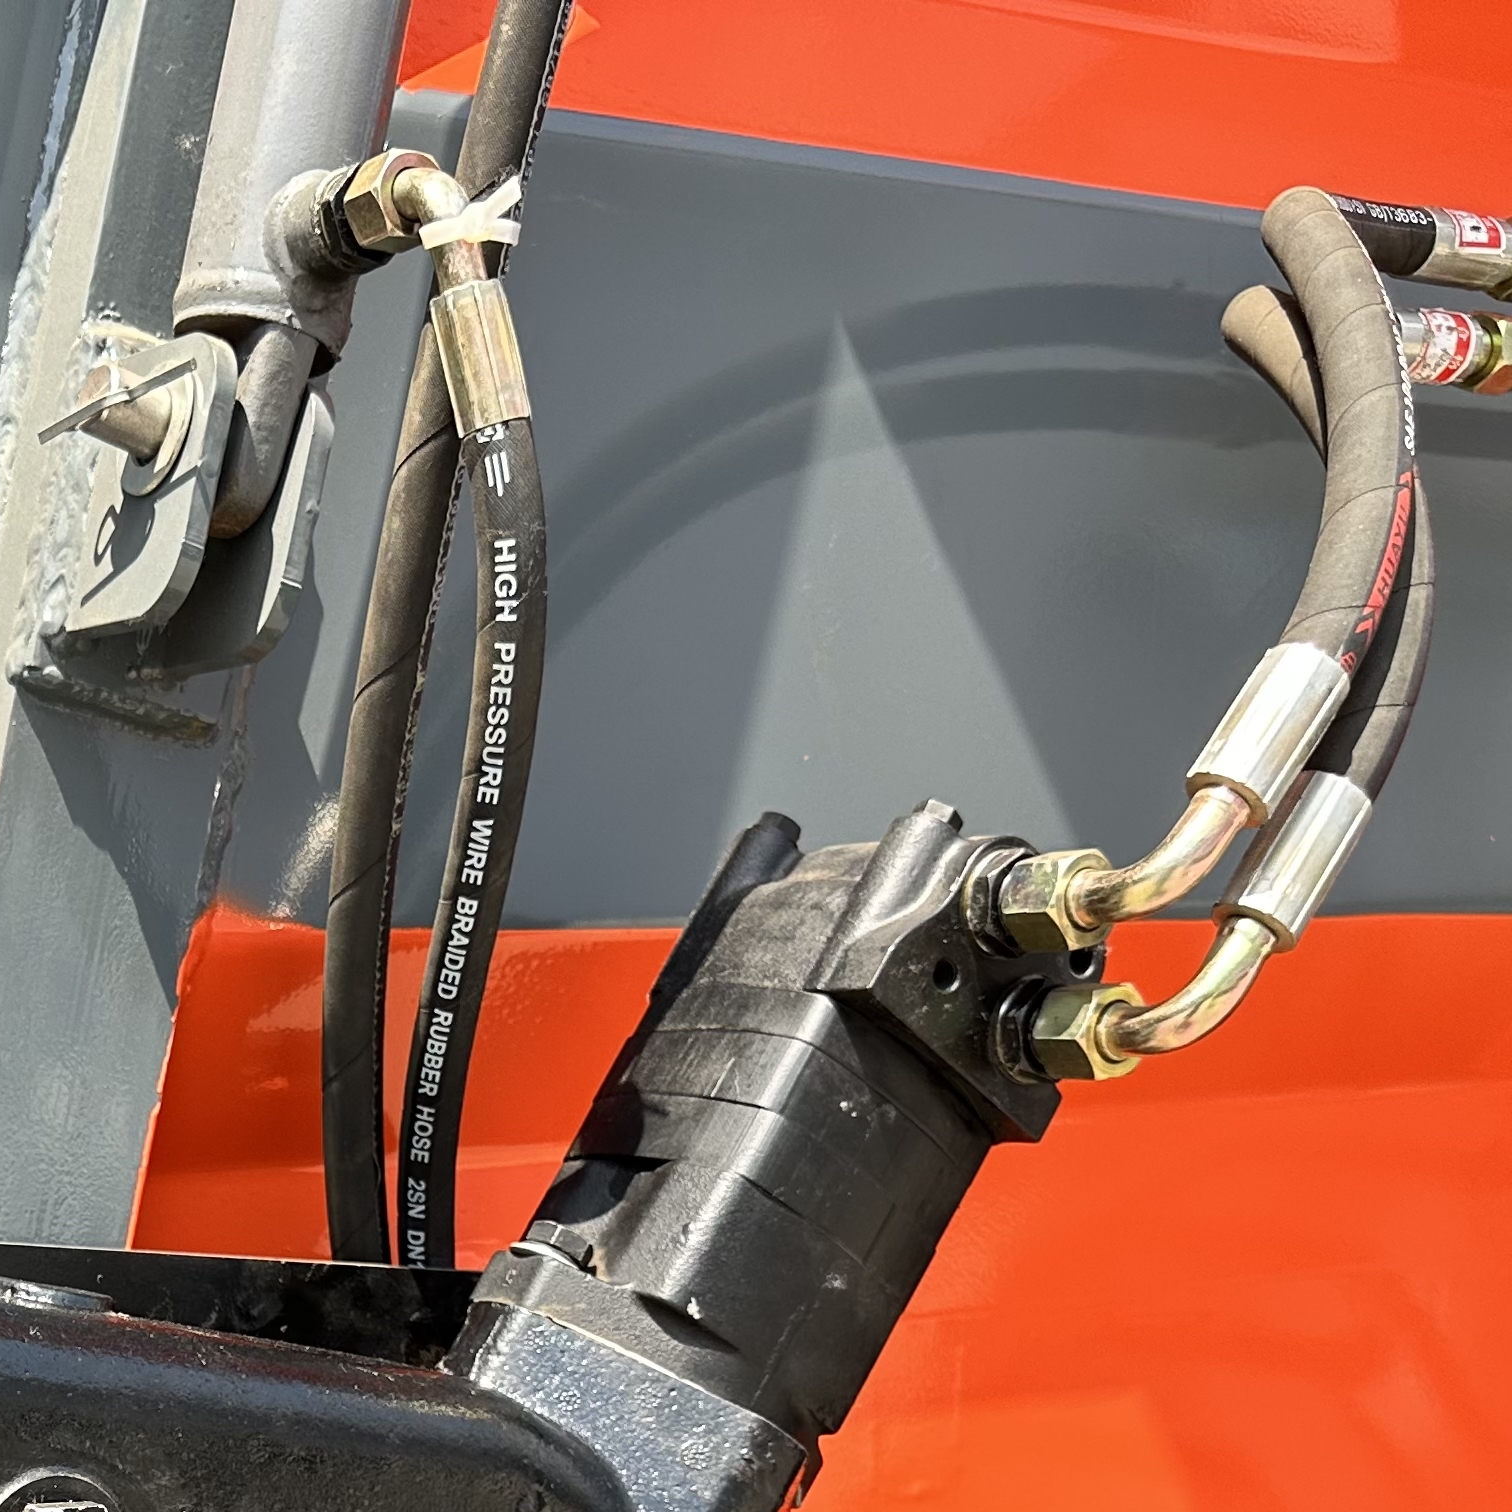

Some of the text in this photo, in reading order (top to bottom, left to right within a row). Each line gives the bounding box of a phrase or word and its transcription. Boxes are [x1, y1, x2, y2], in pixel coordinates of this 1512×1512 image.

[493, 538, 518, 622] HIGH
[476, 641, 516, 806] PRESSURE
[461, 818, 494, 887] WIRE
[437, 896, 479, 1001] BRAIDED
[417, 1007, 454, 1098] RUBBER
[410, 1104, 436, 1165] HOSE
[406, 1178, 427, 1220] 2SN
